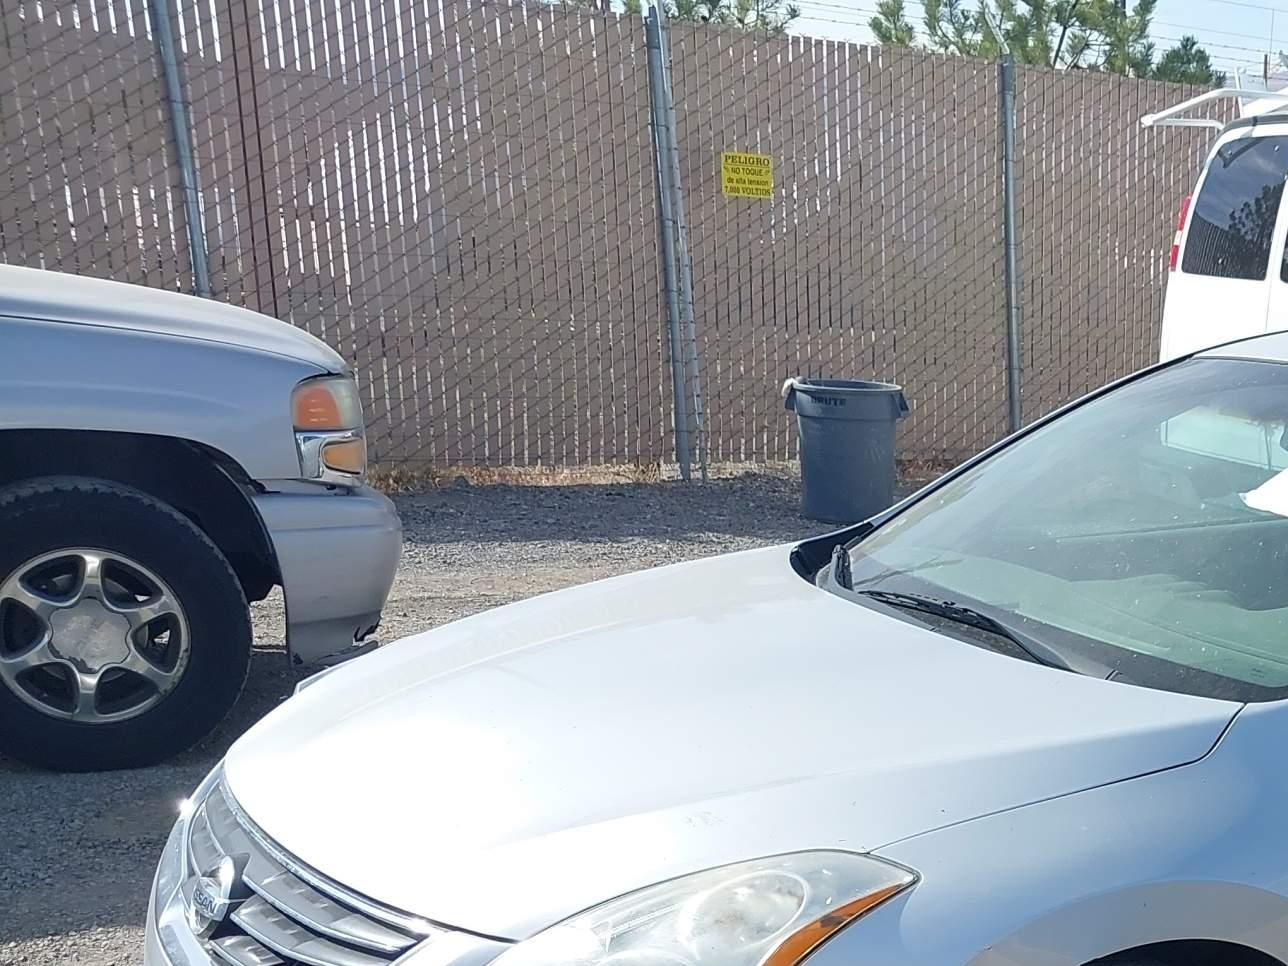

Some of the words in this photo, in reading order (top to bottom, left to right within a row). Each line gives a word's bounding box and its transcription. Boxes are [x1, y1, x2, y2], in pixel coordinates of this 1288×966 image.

[724, 154, 770, 167] PELIGRO
[731, 167, 741, 175] NO
[742, 167, 764, 176] TOQUE
[726, 176, 735, 184] de
[741, 186, 771, 197] VOLTIOS
